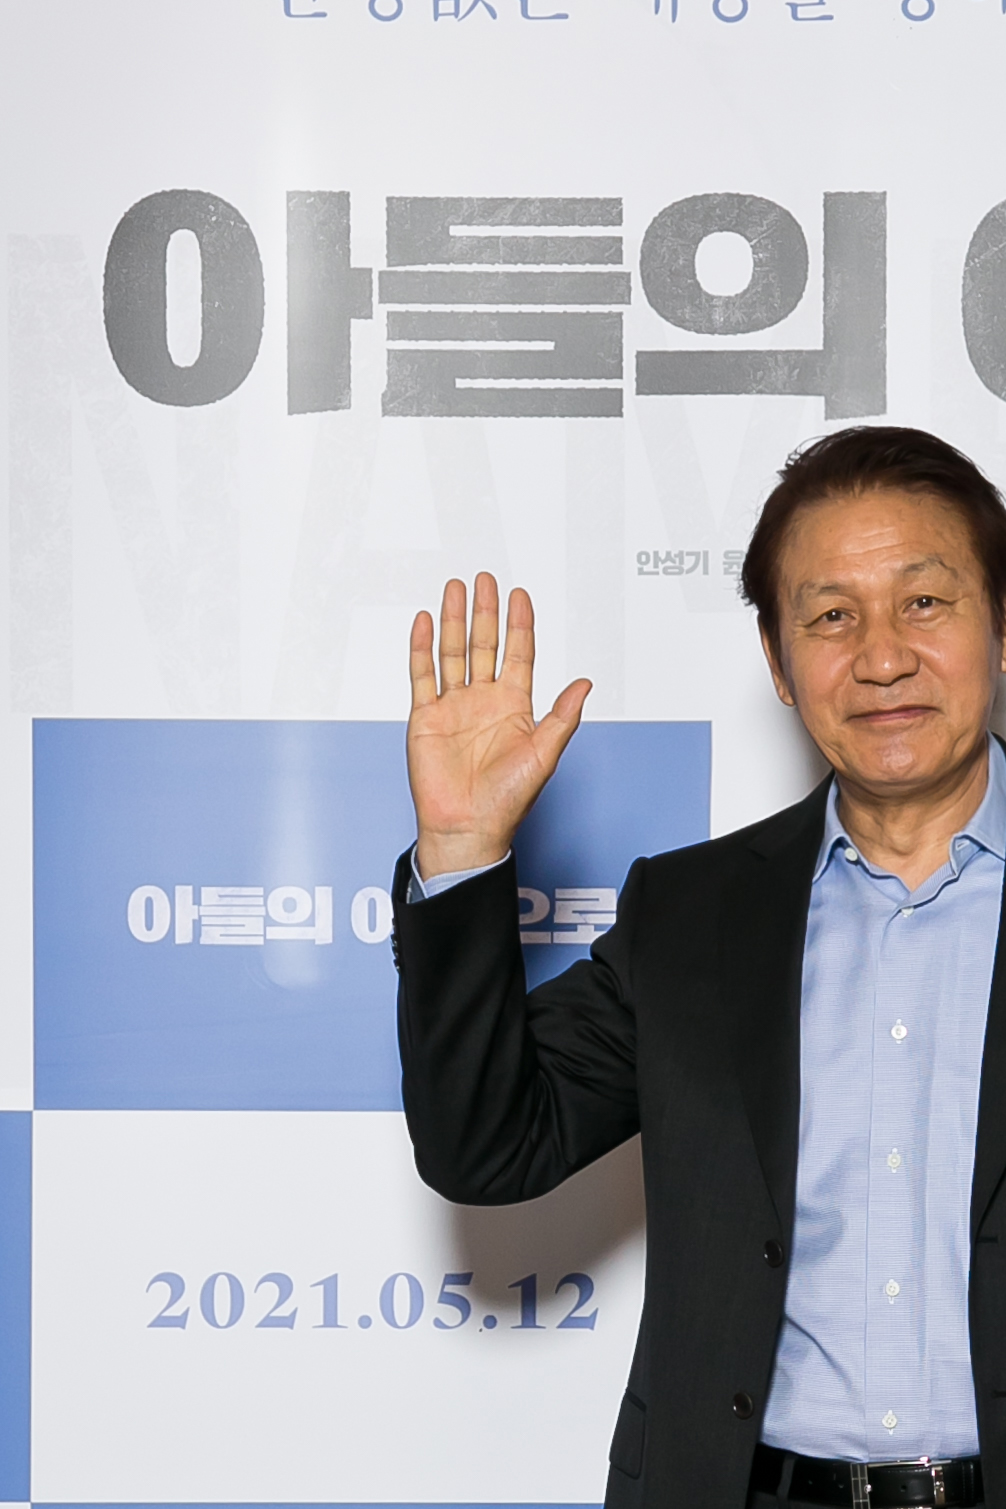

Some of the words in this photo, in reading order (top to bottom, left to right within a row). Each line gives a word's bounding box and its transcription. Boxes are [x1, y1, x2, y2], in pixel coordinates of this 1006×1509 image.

[102, 188, 889, 420] 아들의
[636, 550, 710, 576] 안성기
[127, 885, 333, 945] 아들의
[145, 1271, 599, 1331] 2021.05.12
